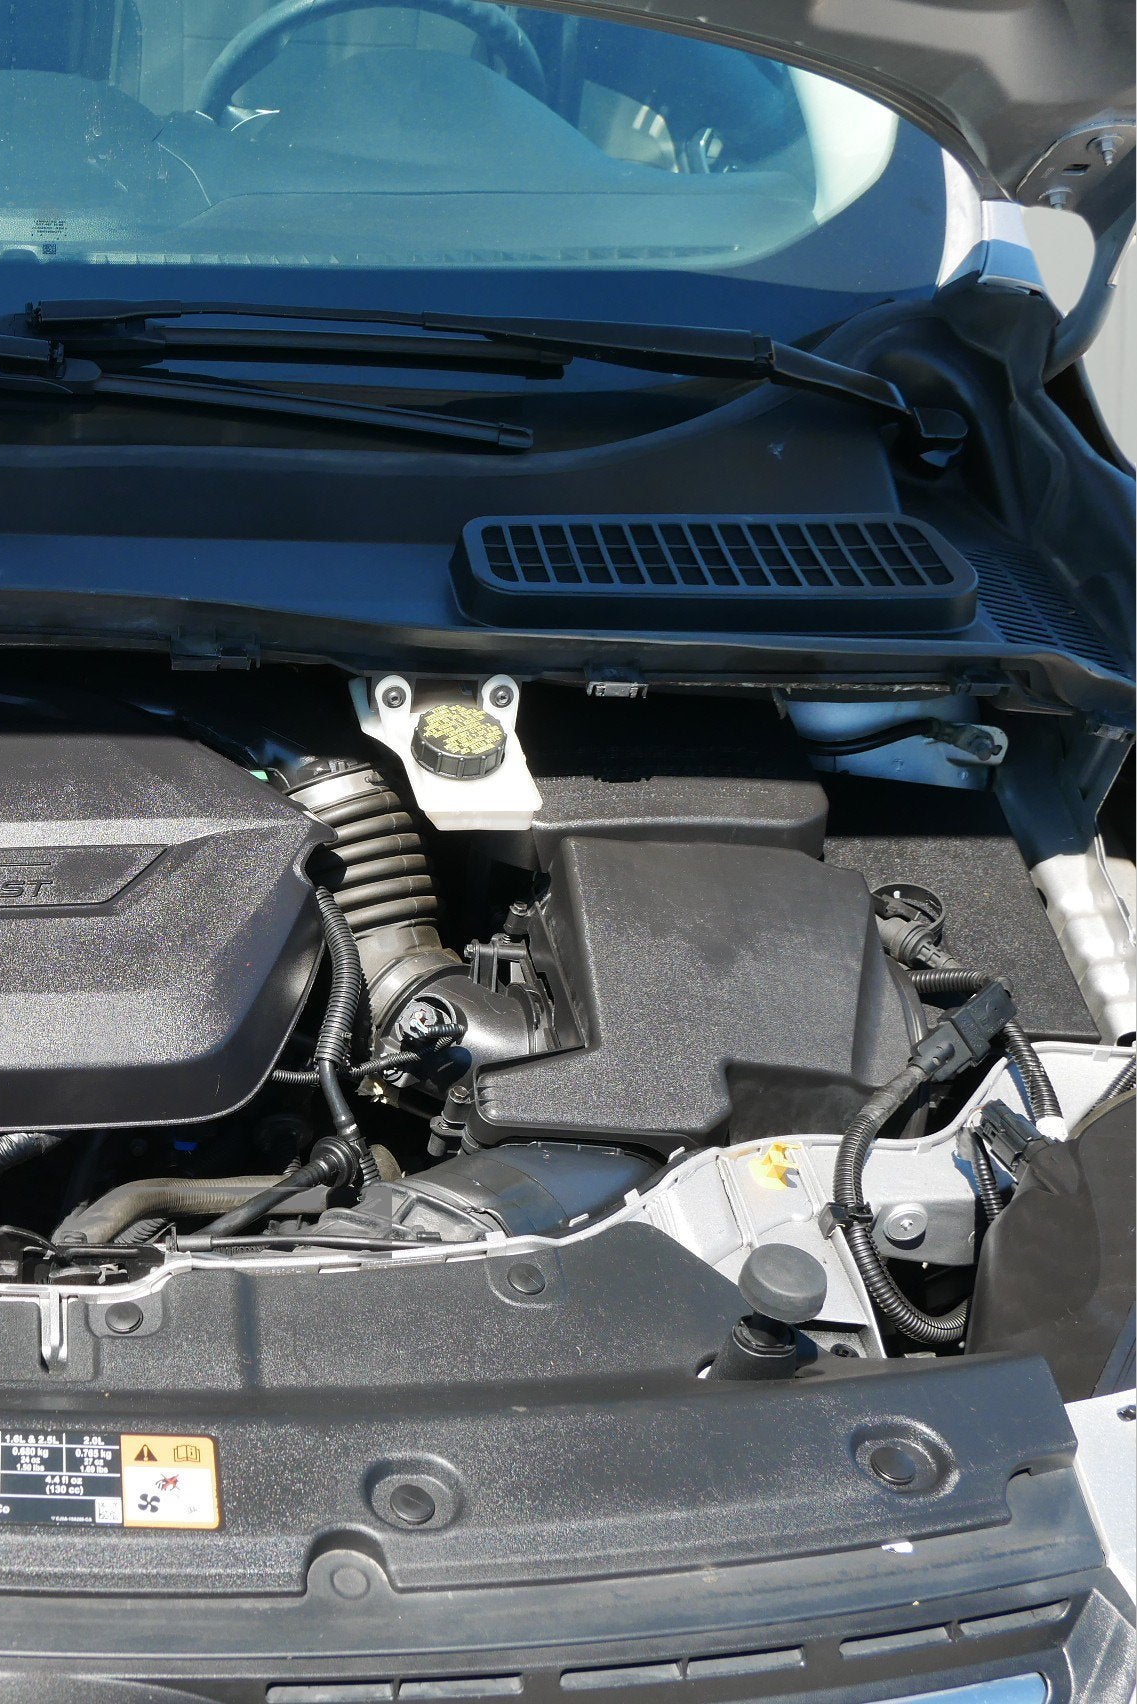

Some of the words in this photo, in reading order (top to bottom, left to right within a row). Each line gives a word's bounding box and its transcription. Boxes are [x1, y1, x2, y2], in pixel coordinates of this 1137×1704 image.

[4, 1434, 26, 1444] 1.6L
[28, 1434, 36, 1444] &
[38, 1435, 60, 1445] 2.5L
[83, 1436, 105, 1446] 2.0L
[37, 1447, 49, 1458] kg
[100, 1449, 112, 1460] kg
[20, 1456, 30, 1464] 24
[83, 1458, 93, 1466] 27
[45, 1475, 60, 1485] 4.4
[61, 1475, 69, 1485] fl
[70, 1477, 83, 1485] oz
[45, 1485, 67, 1495] (130
[68, 1486, 84, 1496] cc)
